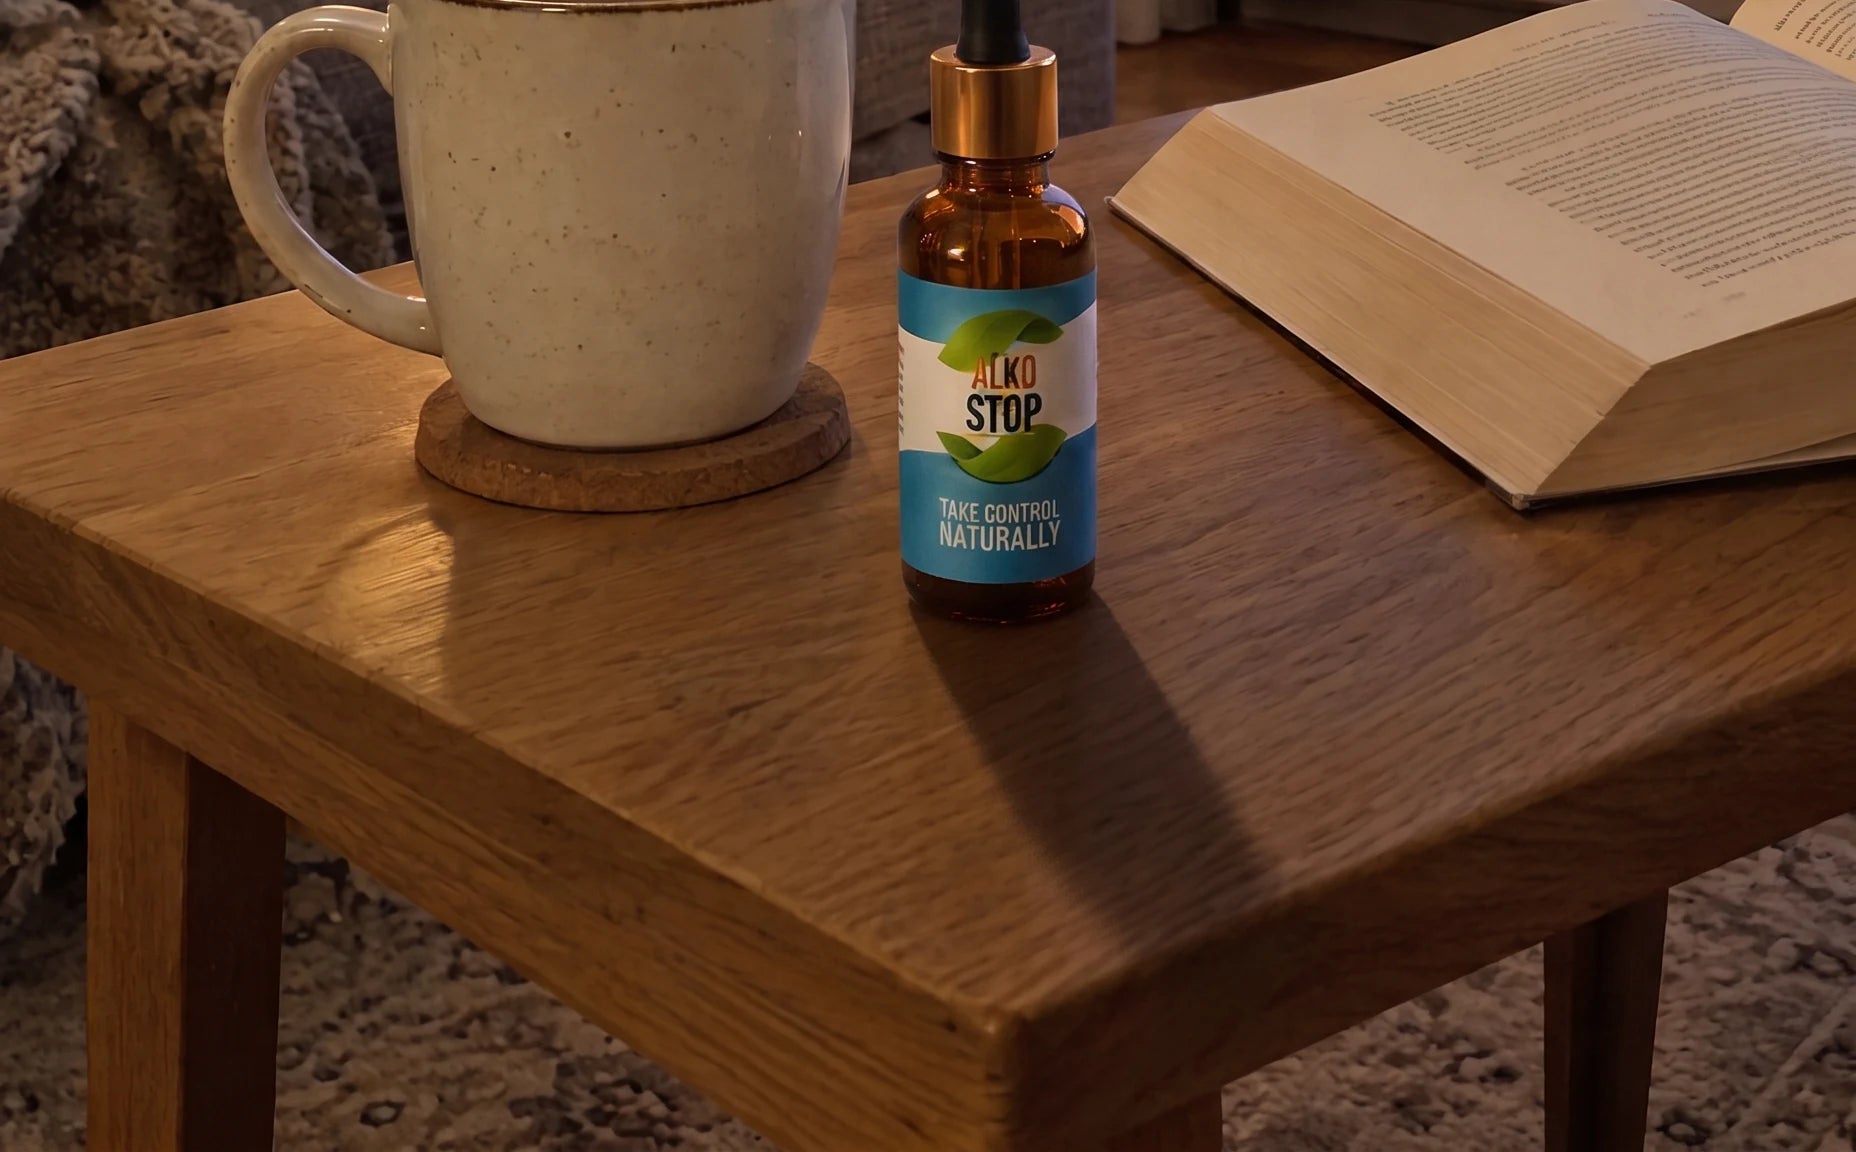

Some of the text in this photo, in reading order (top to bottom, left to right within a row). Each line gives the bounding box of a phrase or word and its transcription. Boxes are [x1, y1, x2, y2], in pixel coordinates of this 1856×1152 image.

[971, 354, 1036, 389] ALKO
[966, 393, 1042, 433] STOP
[939, 497, 1060, 523] TAKE CONTROL
[939, 520, 1061, 551] NATURALLY
